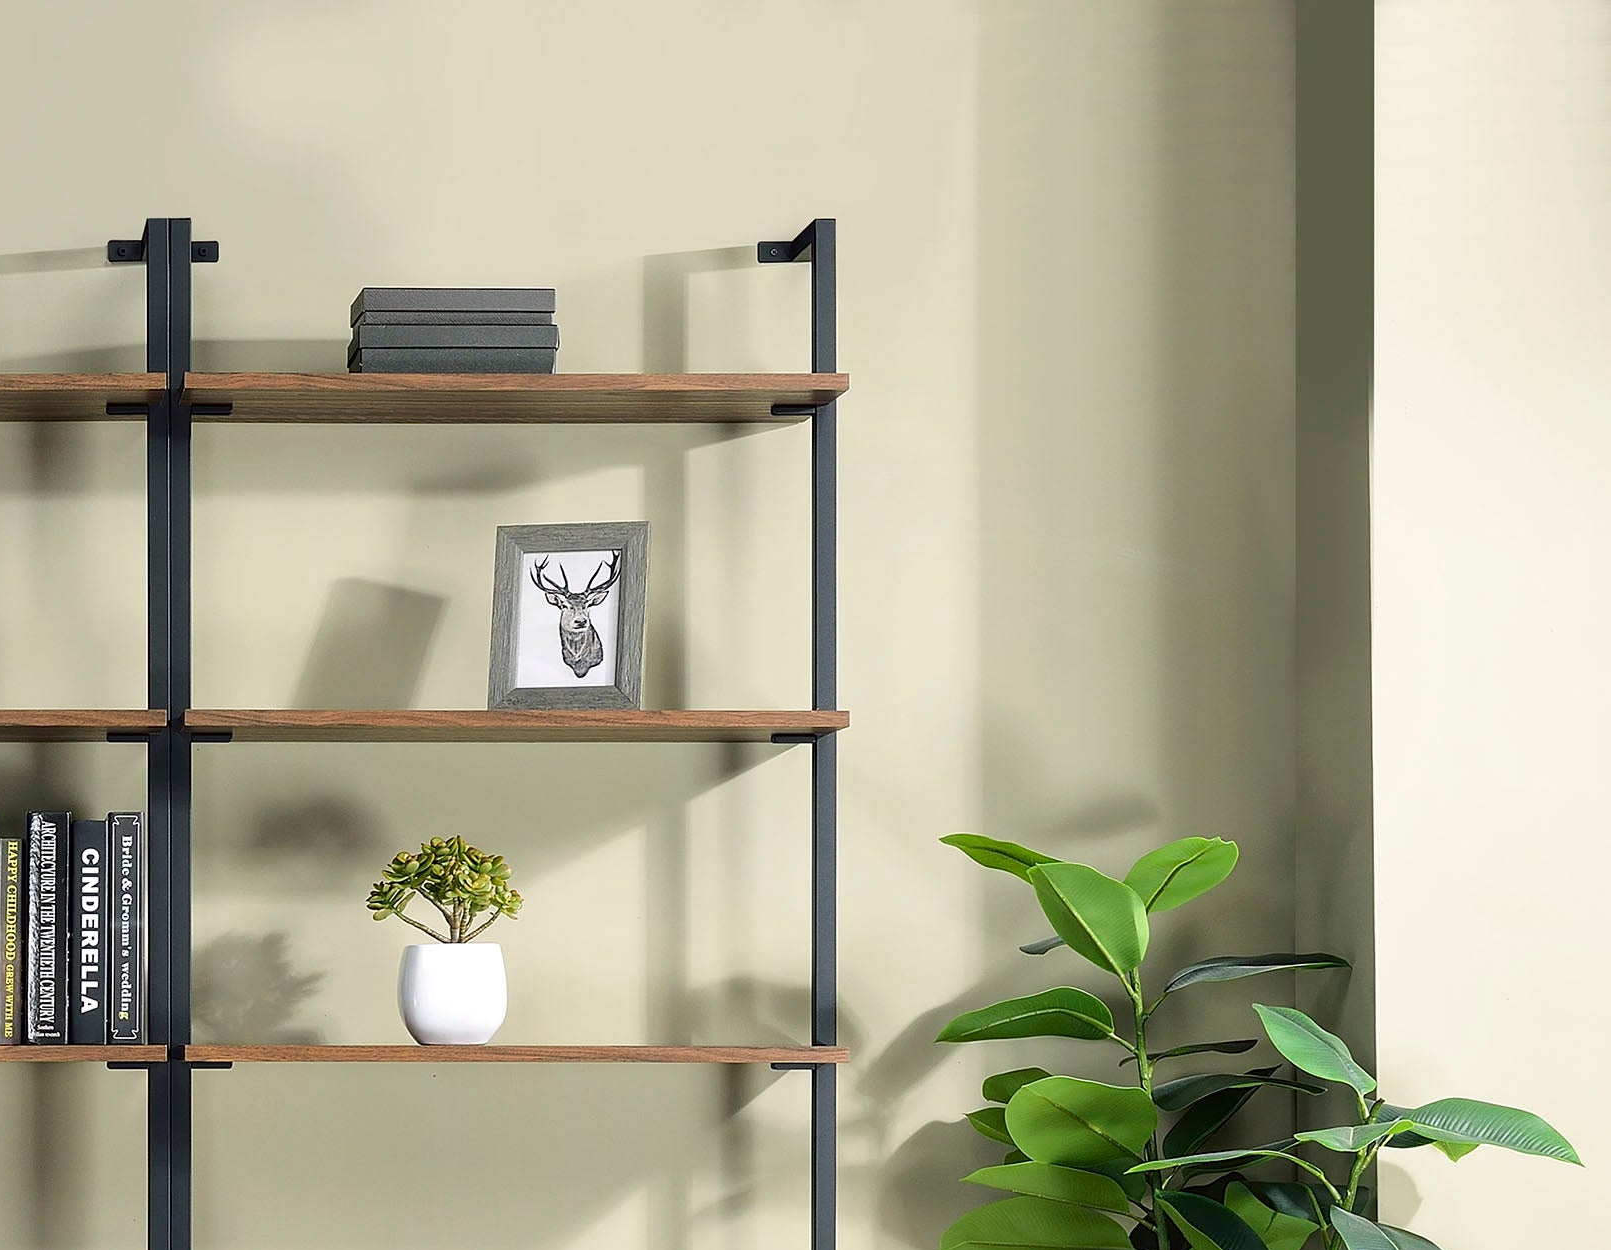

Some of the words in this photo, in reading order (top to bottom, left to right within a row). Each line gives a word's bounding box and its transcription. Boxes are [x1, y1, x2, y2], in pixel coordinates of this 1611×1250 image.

[6, 840, 18, 883] HAPPY
[120, 835, 133, 876] Bride
[40, 892, 56, 904] IN
[121, 877, 133, 892] &
[5, 884, 17, 961] CHILDHOOD
[40, 904, 56, 924] THE
[80, 847, 100, 1014] CINDERELLA
[39, 924, 56, 979] TWENTIETH
[5, 963, 14, 993] GREW
[118, 961, 133, 1021] wedding
[5, 995, 14, 1020] WITH
[39, 979, 56, 1023] CENTURY
[4, 1021, 13, 1038] ME
